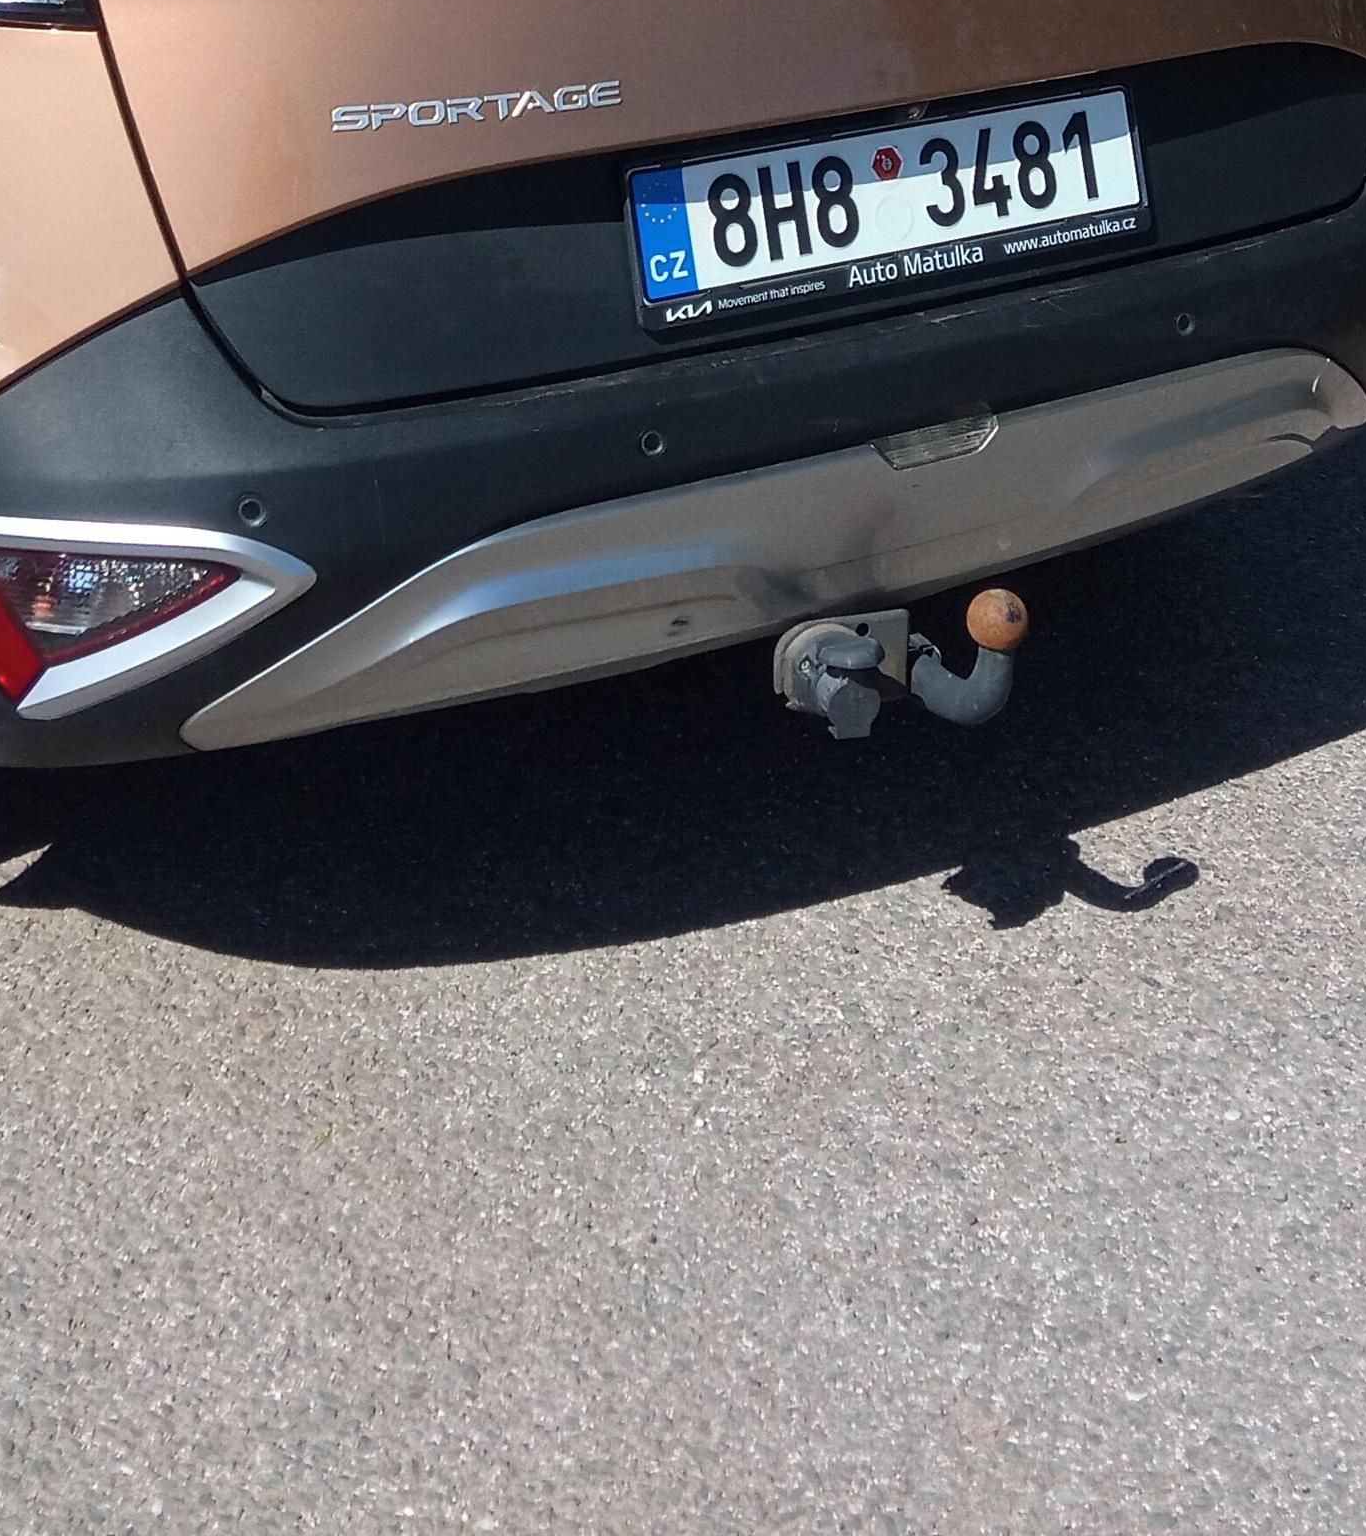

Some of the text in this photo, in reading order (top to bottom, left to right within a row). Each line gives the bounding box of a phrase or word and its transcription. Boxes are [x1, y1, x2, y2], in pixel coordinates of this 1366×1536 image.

[331, 80, 623, 131] SPORTAGE
[708, 111, 1099, 267] 8H8 3481
[650, 250, 689, 282] CZ
[718, 290, 768, 310] Movement
[769, 286, 788, 301] that
[790, 280, 826, 298] inspires
[848, 260, 898, 289] Auto
[904, 244, 984, 277] Matulka
[1004, 217, 1137, 255] www.automatulka.cz
